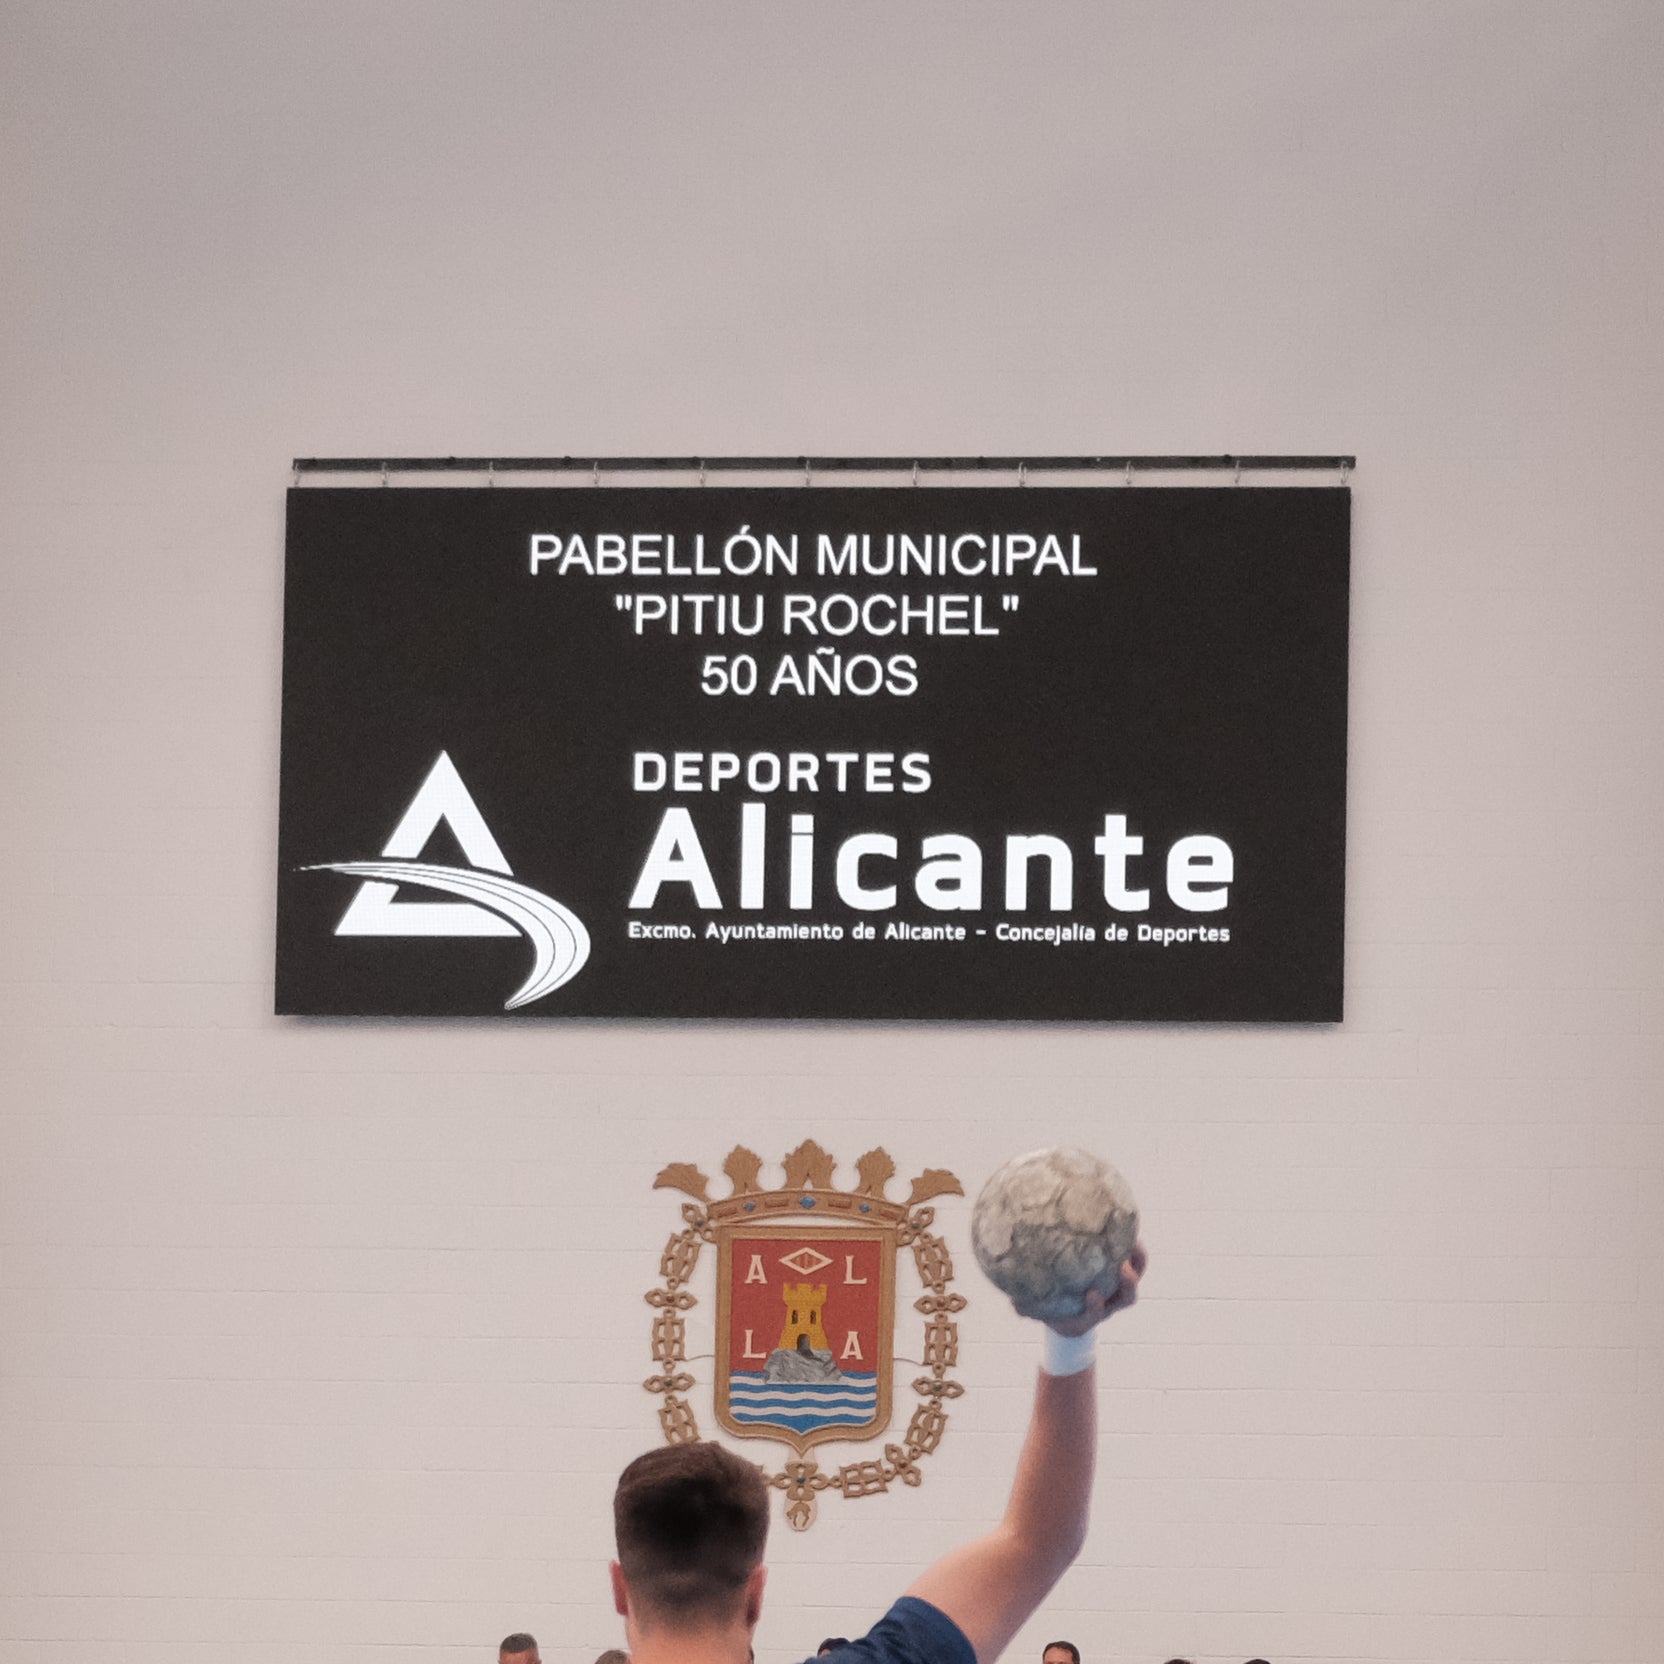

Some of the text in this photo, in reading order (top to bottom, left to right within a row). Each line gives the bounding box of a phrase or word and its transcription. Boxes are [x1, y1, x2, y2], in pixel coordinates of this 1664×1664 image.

[530, 524, 1098, 576] PABELLÓN MUNICIPAL
[615, 593, 1020, 637] "PITIU ROCHEL"
[701, 646, 919, 697] 50 AÑOS
[633, 751, 932, 794] DEPORTES
[627, 801, 1235, 913] Alicante
[627, 920, 697, 940] Excmo.
[704, 921, 844, 945] Ayuntamiento
[851, 921, 876, 940] de
[884, 921, 967, 941] Alicante
[995, 922, 1096, 947] Concejalía
[1104, 922, 1129, 942] de
[1137, 923, 1231, 947] Deportes
[744, 1255, 867, 1284] A L
[742, 1329, 864, 1360] L A
